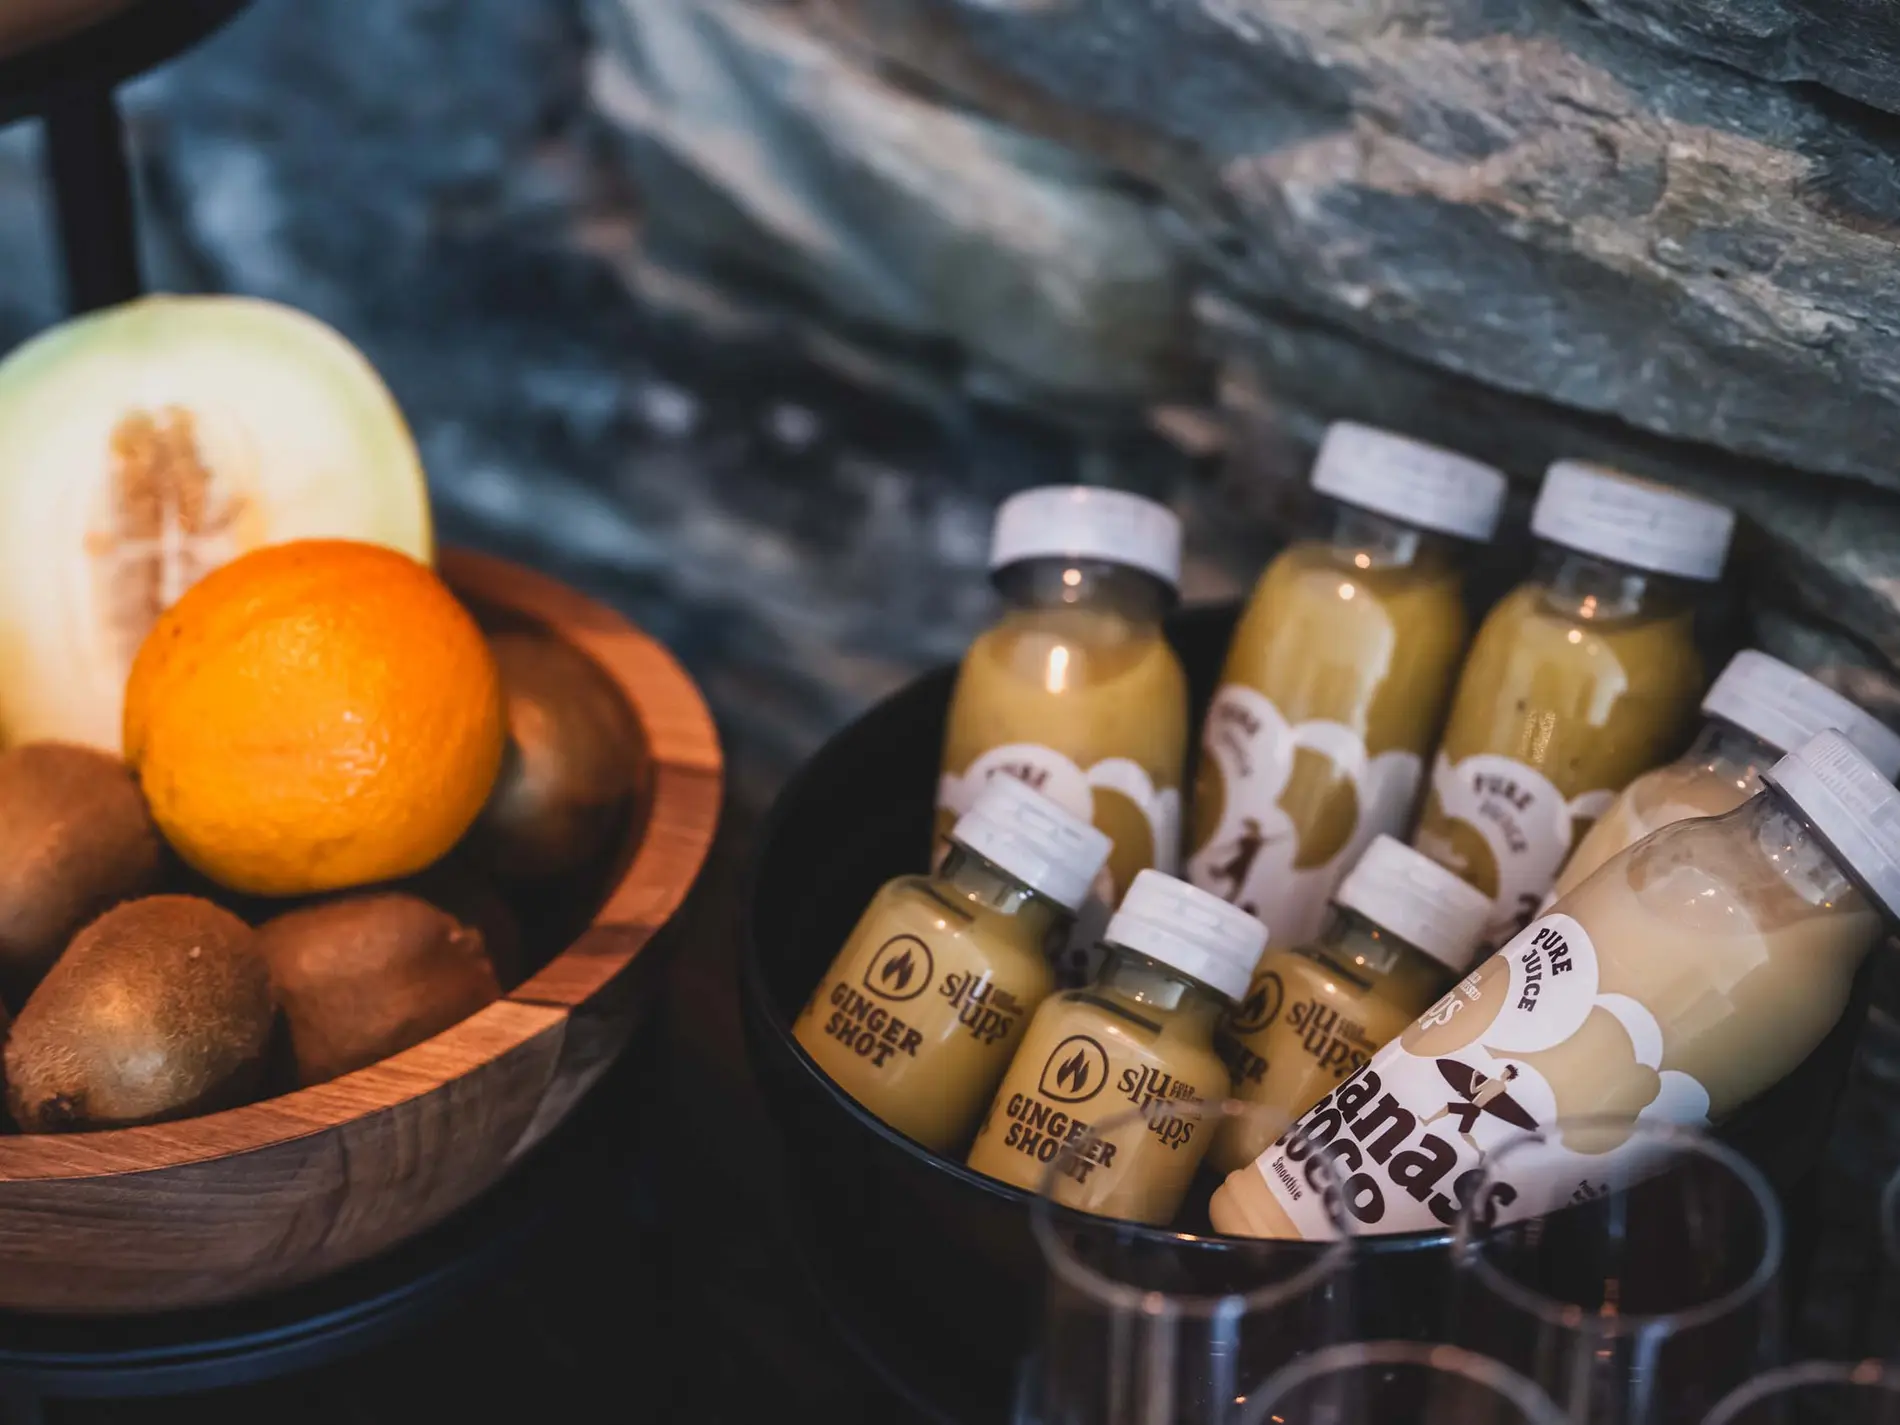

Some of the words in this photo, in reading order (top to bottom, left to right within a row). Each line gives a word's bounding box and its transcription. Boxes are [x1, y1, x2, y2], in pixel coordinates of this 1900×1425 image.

[1517, 949, 1542, 1012] JUICE
[1531, 927, 1573, 976] PURE
[824, 1011, 895, 1069] SHOT
[830, 981, 923, 1057] GINGER
[1004, 1122, 1096, 1184] SHOT
[1006, 1093, 1118, 1168] GINGER
[1276, 1093, 1386, 1224] oco
[1336, 1059, 1518, 1230] anas
[1271, 1156, 1304, 1202] Smoothie
